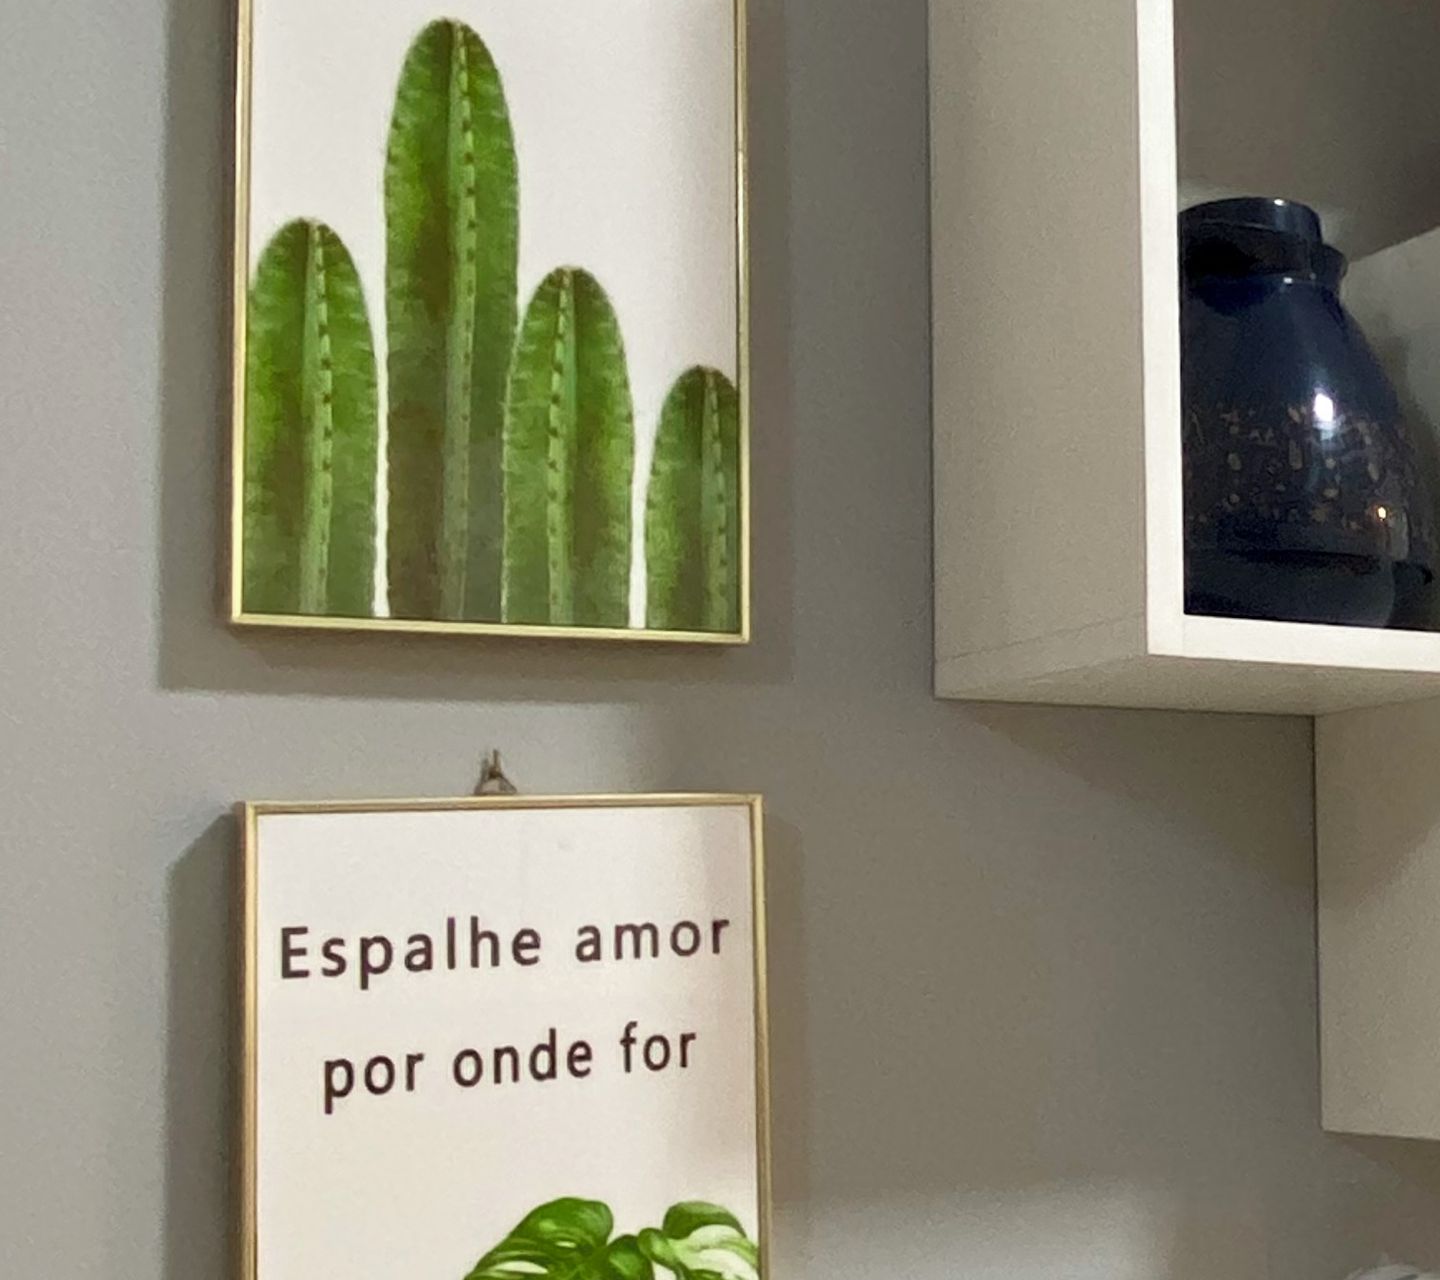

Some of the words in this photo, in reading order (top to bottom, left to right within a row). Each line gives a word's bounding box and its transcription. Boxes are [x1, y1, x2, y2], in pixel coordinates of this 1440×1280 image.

[281, 915, 541, 991] Espalhe
[575, 918, 731, 963] amor
[324, 1052, 425, 1115] por
[452, 1027, 593, 1088] onde
[619, 1020, 697, 1074] for
